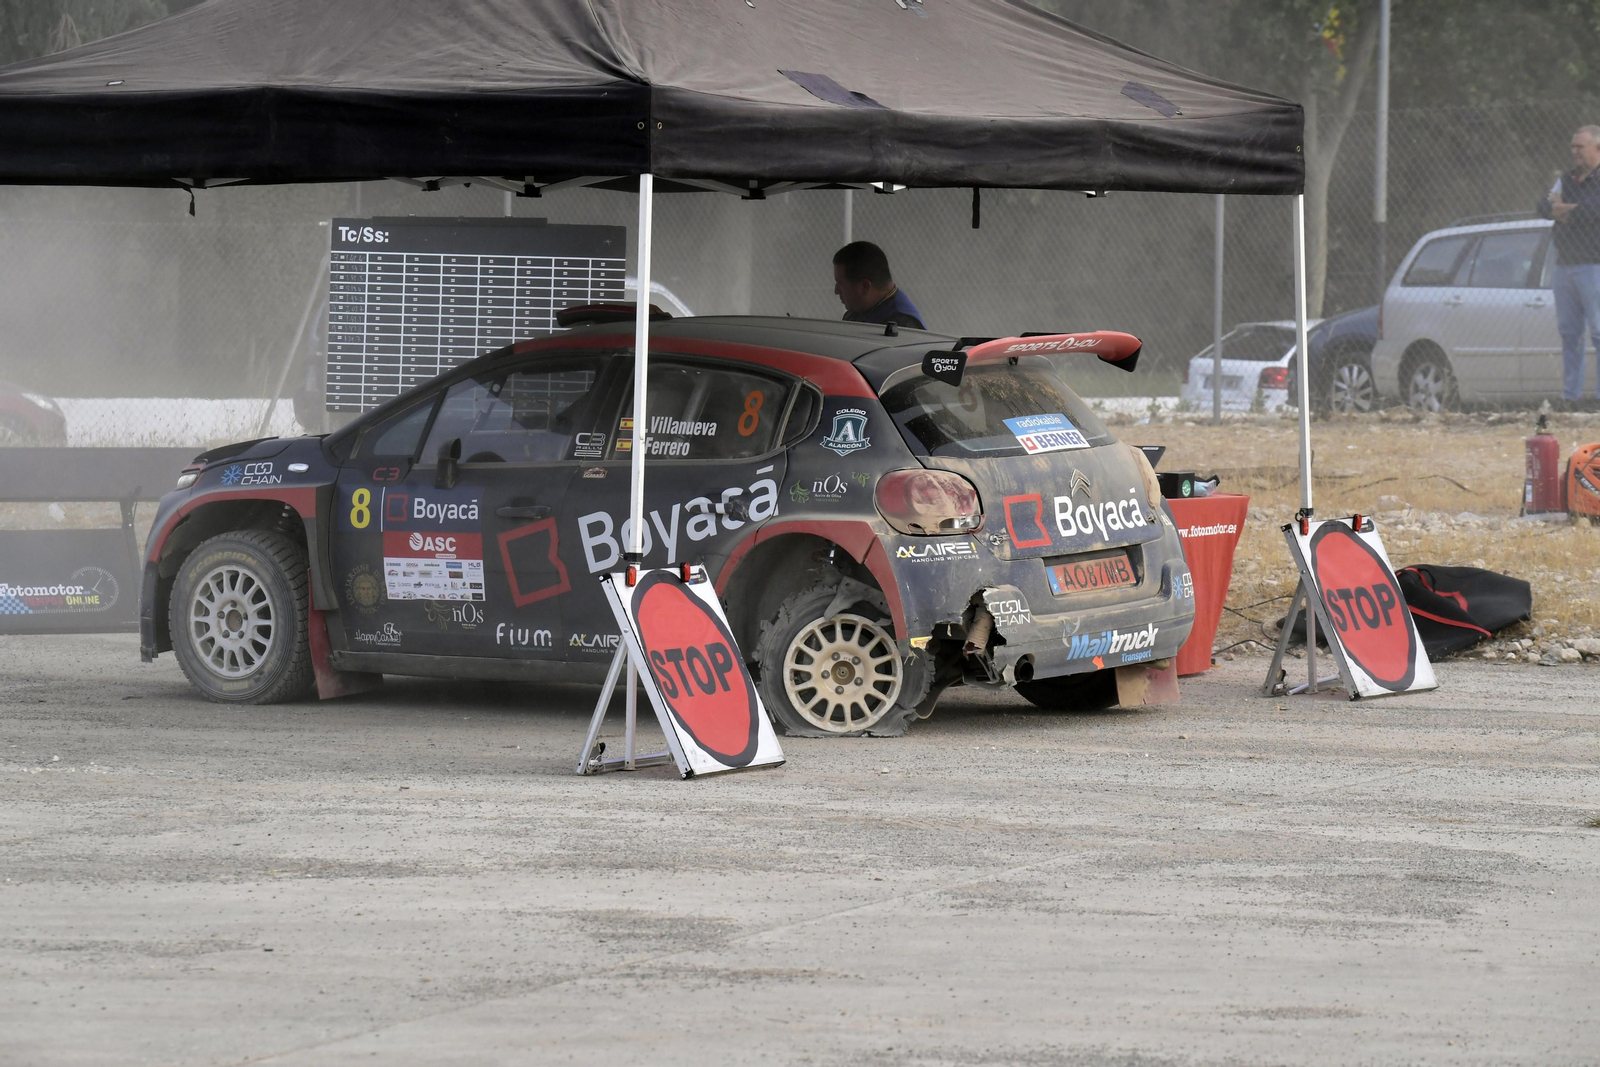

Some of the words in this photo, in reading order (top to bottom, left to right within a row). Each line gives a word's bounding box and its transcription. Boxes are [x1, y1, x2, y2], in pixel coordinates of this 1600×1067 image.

[338, 226, 390, 244] Tc/Ss:
[931, 357, 959, 365] SPORTS
[738, 390, 764, 437] 8
[836, 408, 867, 416] COLEGIO
[650, 416, 718, 437] Villanueva
[645, 437, 691, 457] Ferrero
[1034, 431, 1087, 449] BERNER
[240, 474, 283, 486] CHAIN
[372, 467, 401, 481] C3
[350, 488, 371, 529] 8
[413, 498, 479, 524] Boyacá
[1053, 487, 1148, 542] Boyacá
[578, 465, 780, 574] Boyacá
[423, 536, 457, 552] ASC
[189, 551, 258, 582] SCORPION
[65, 595, 100, 605] ONLINE
[1326, 583, 1396, 632] STOP
[1066, 622, 1159, 661] Mailtruck
[1121, 648, 1152, 663] Transport
[650, 642, 733, 699] STOP
